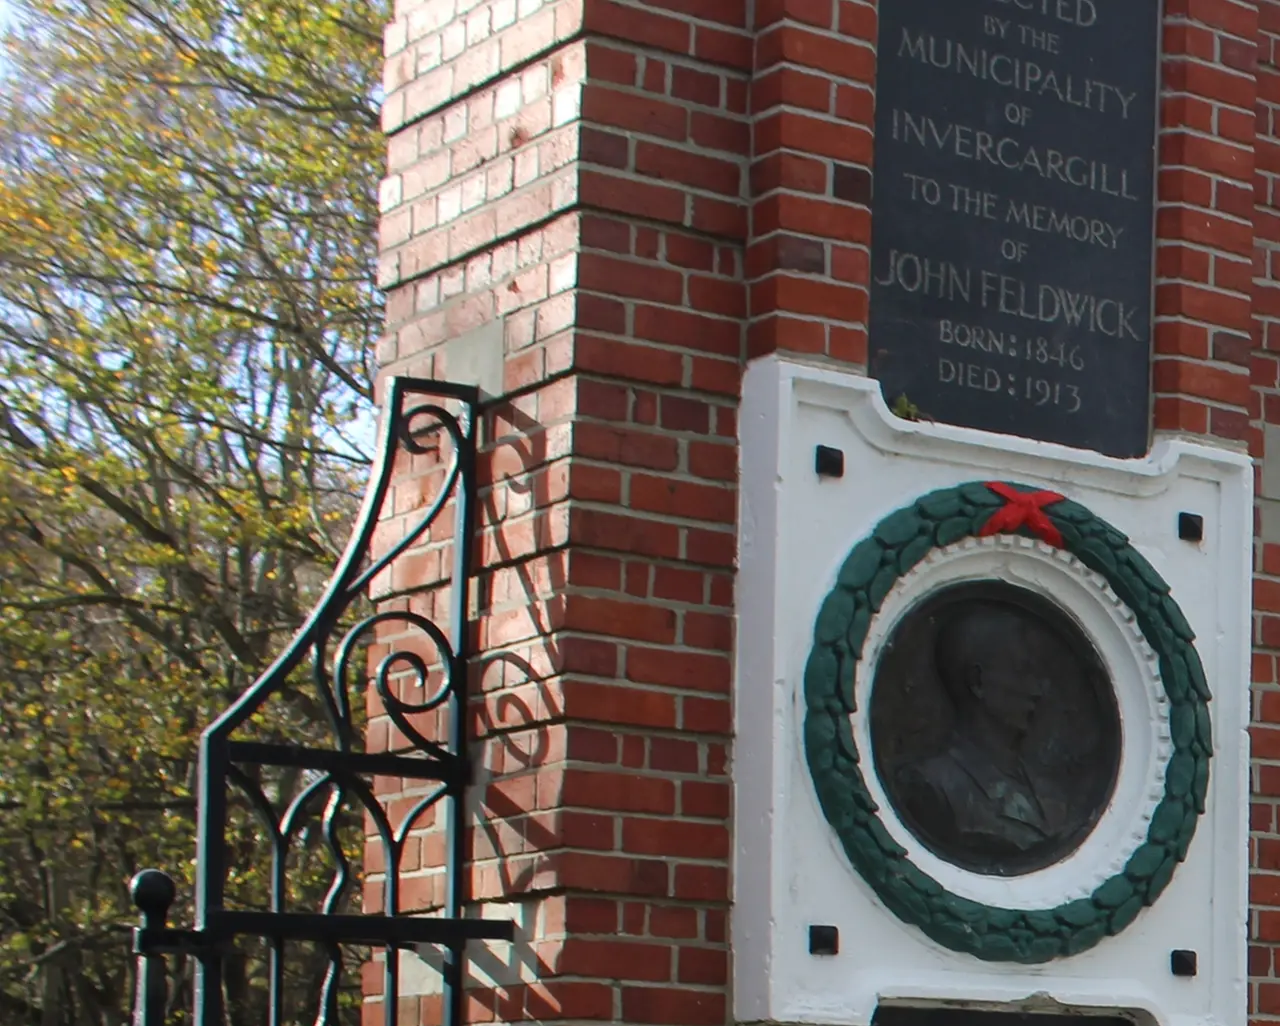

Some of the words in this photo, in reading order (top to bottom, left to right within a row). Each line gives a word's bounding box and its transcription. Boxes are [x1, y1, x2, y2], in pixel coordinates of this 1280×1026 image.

[984, 14, 1011, 39] BY
[1018, 24, 1060, 55] THE
[898, 28, 1137, 119] MUNICIPALITY
[1005, 102, 1032, 126] OF
[892, 109, 1138, 201] INVERCARGILL
[904, 173, 940, 205] TO
[949, 185, 996, 219] THE
[1005, 200, 1124, 249] MEMORY
[1001, 239, 1029, 262] OF
[875, 250, 970, 301] JOHN
[981, 271, 1144, 342] FELDWICK
[1026, 337, 1085, 371] 1846
[1026, 376, 1081, 413] 1913
